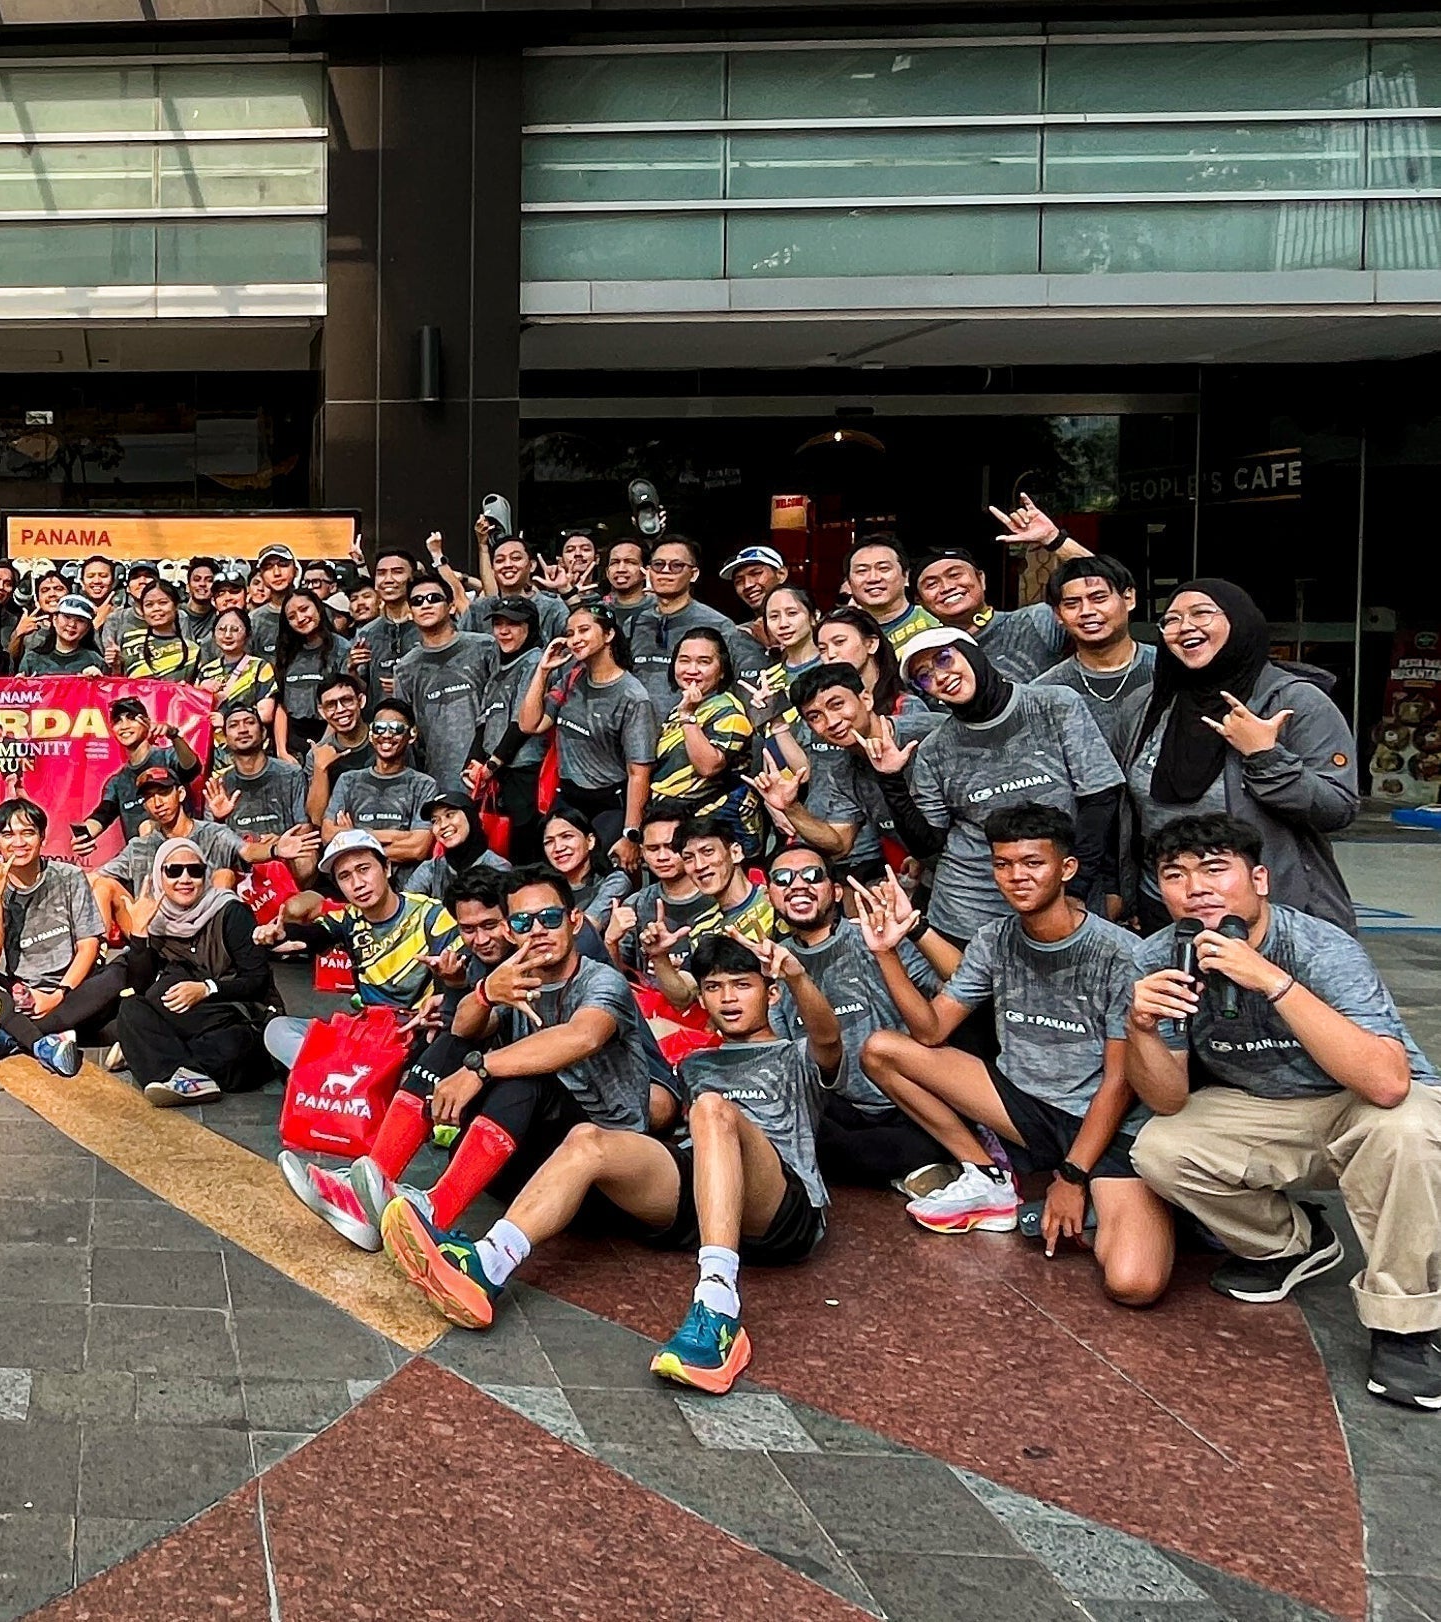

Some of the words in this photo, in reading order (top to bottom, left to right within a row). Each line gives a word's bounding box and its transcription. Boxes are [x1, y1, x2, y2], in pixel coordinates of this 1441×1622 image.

[1233, 460, 1303, 491] CAFE
[21, 528, 112, 547] PANAMA
[1001, 774, 1053, 794] PANAMA
[320, 955, 354, 970] PANA
[1036, 1015, 1087, 1034] PANAMA
[1245, 1037, 1302, 1053] PANAMA
[295, 1091, 373, 1121] PANAMA
